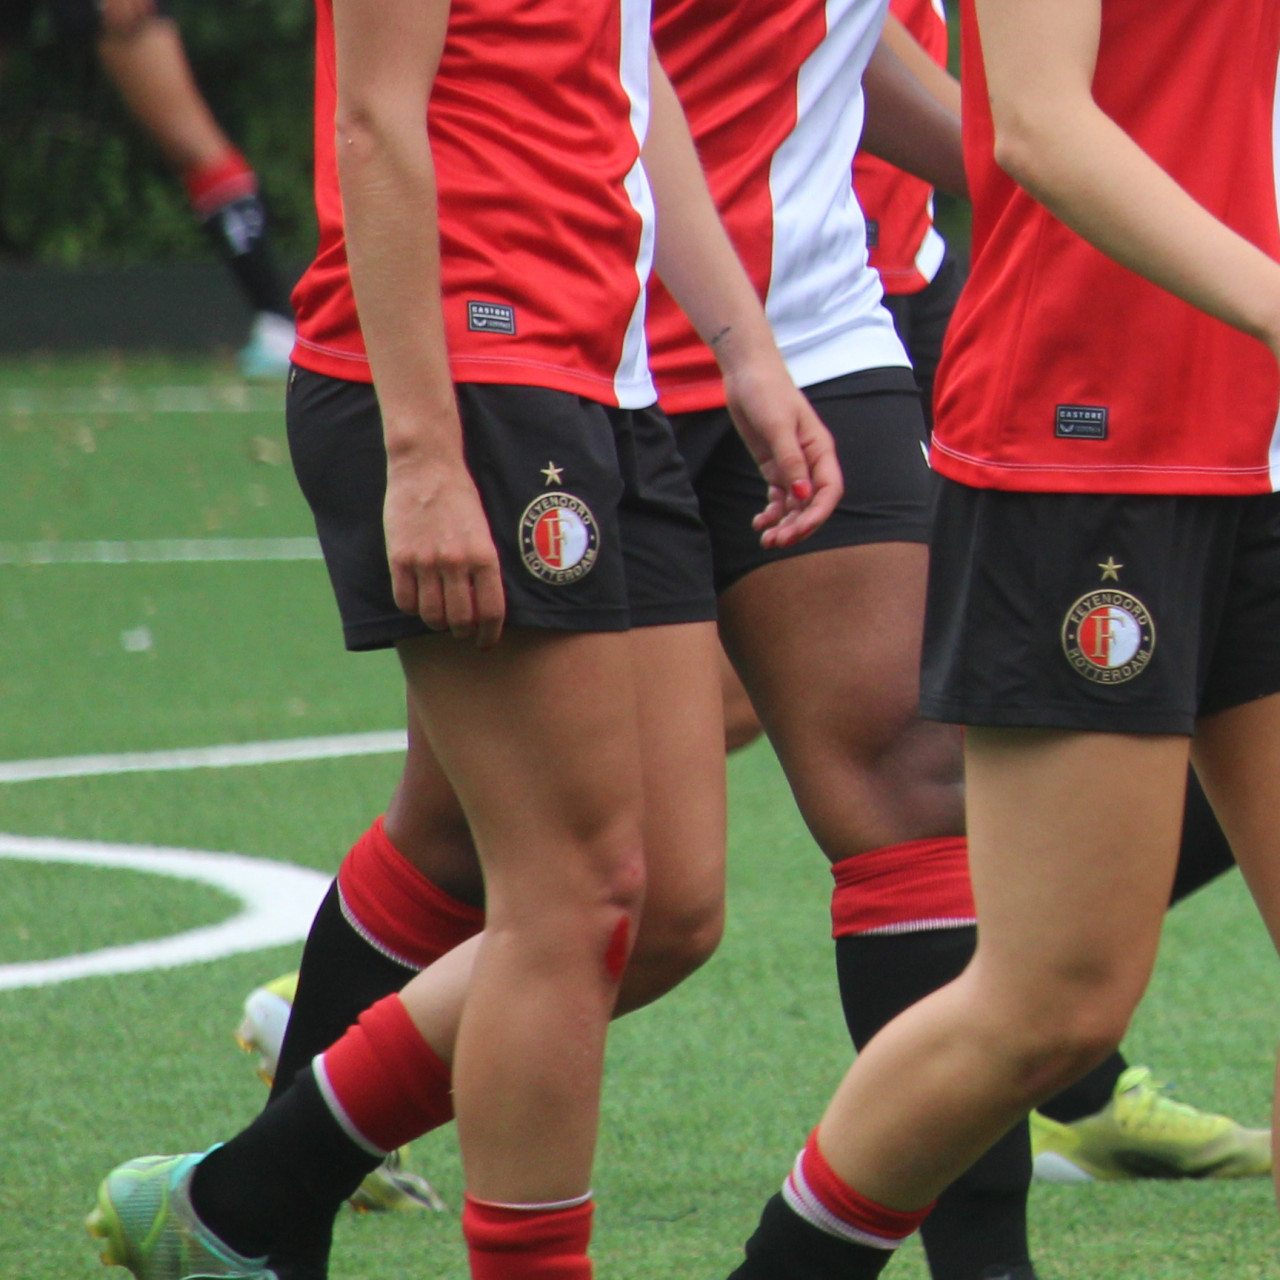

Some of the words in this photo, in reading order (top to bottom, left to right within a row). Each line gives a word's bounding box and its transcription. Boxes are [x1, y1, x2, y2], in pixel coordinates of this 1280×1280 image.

[1060, 411, 1102, 420] CASTORE
[524, 496, 592, 528] FEYENOORD
[525, 549, 598, 582] ROTTERDAM
[1070, 593, 1148, 626] FEYENOORD
[1068, 648, 1150, 682] ROTTERDAM
